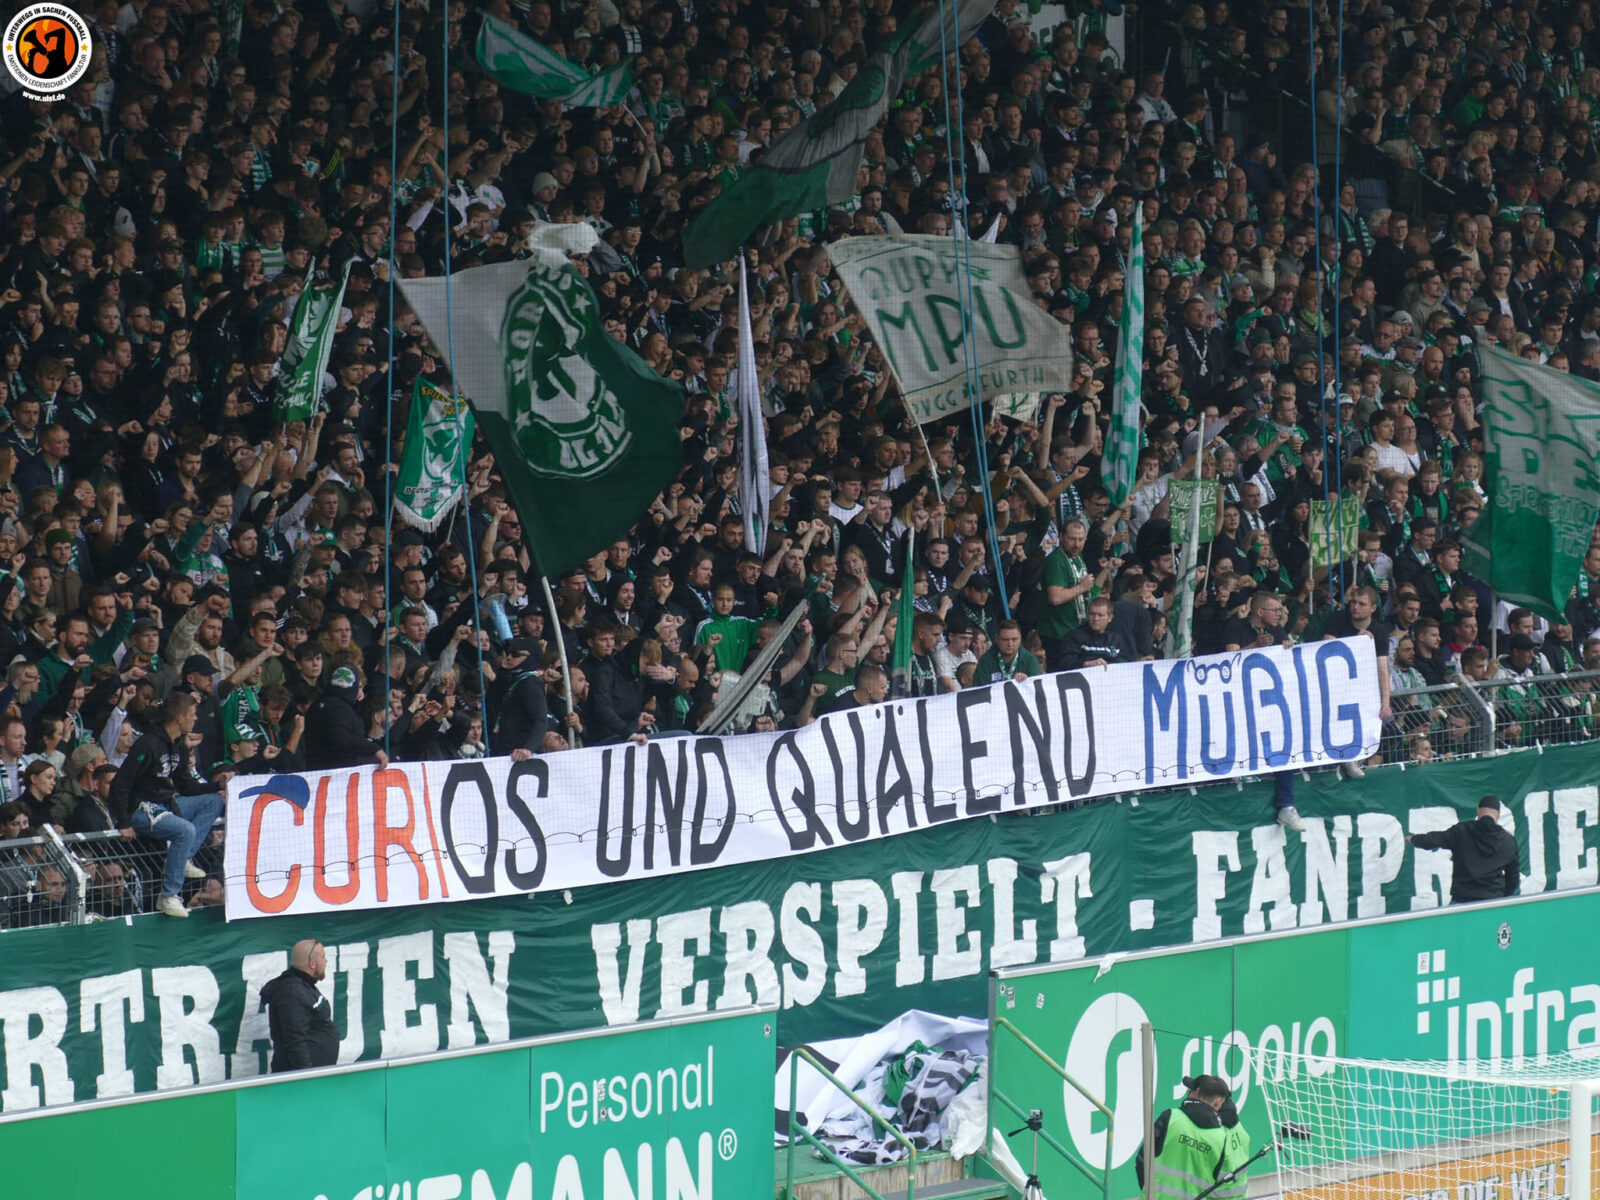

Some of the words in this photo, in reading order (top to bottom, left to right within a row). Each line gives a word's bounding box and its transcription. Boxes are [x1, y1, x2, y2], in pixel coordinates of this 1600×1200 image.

[876, 285, 1027, 375] MPU
[245, 758, 548, 913] CURIOS
[597, 737, 737, 878] UND
[766, 672, 1096, 851] QUÄLEND
[591, 852, 1093, 1025] VERSPIELT
[1192, 785, 1599, 942] FANPRJE
[1447, 967, 1600, 1082] infra
[540, 1045, 714, 1133] Personal
